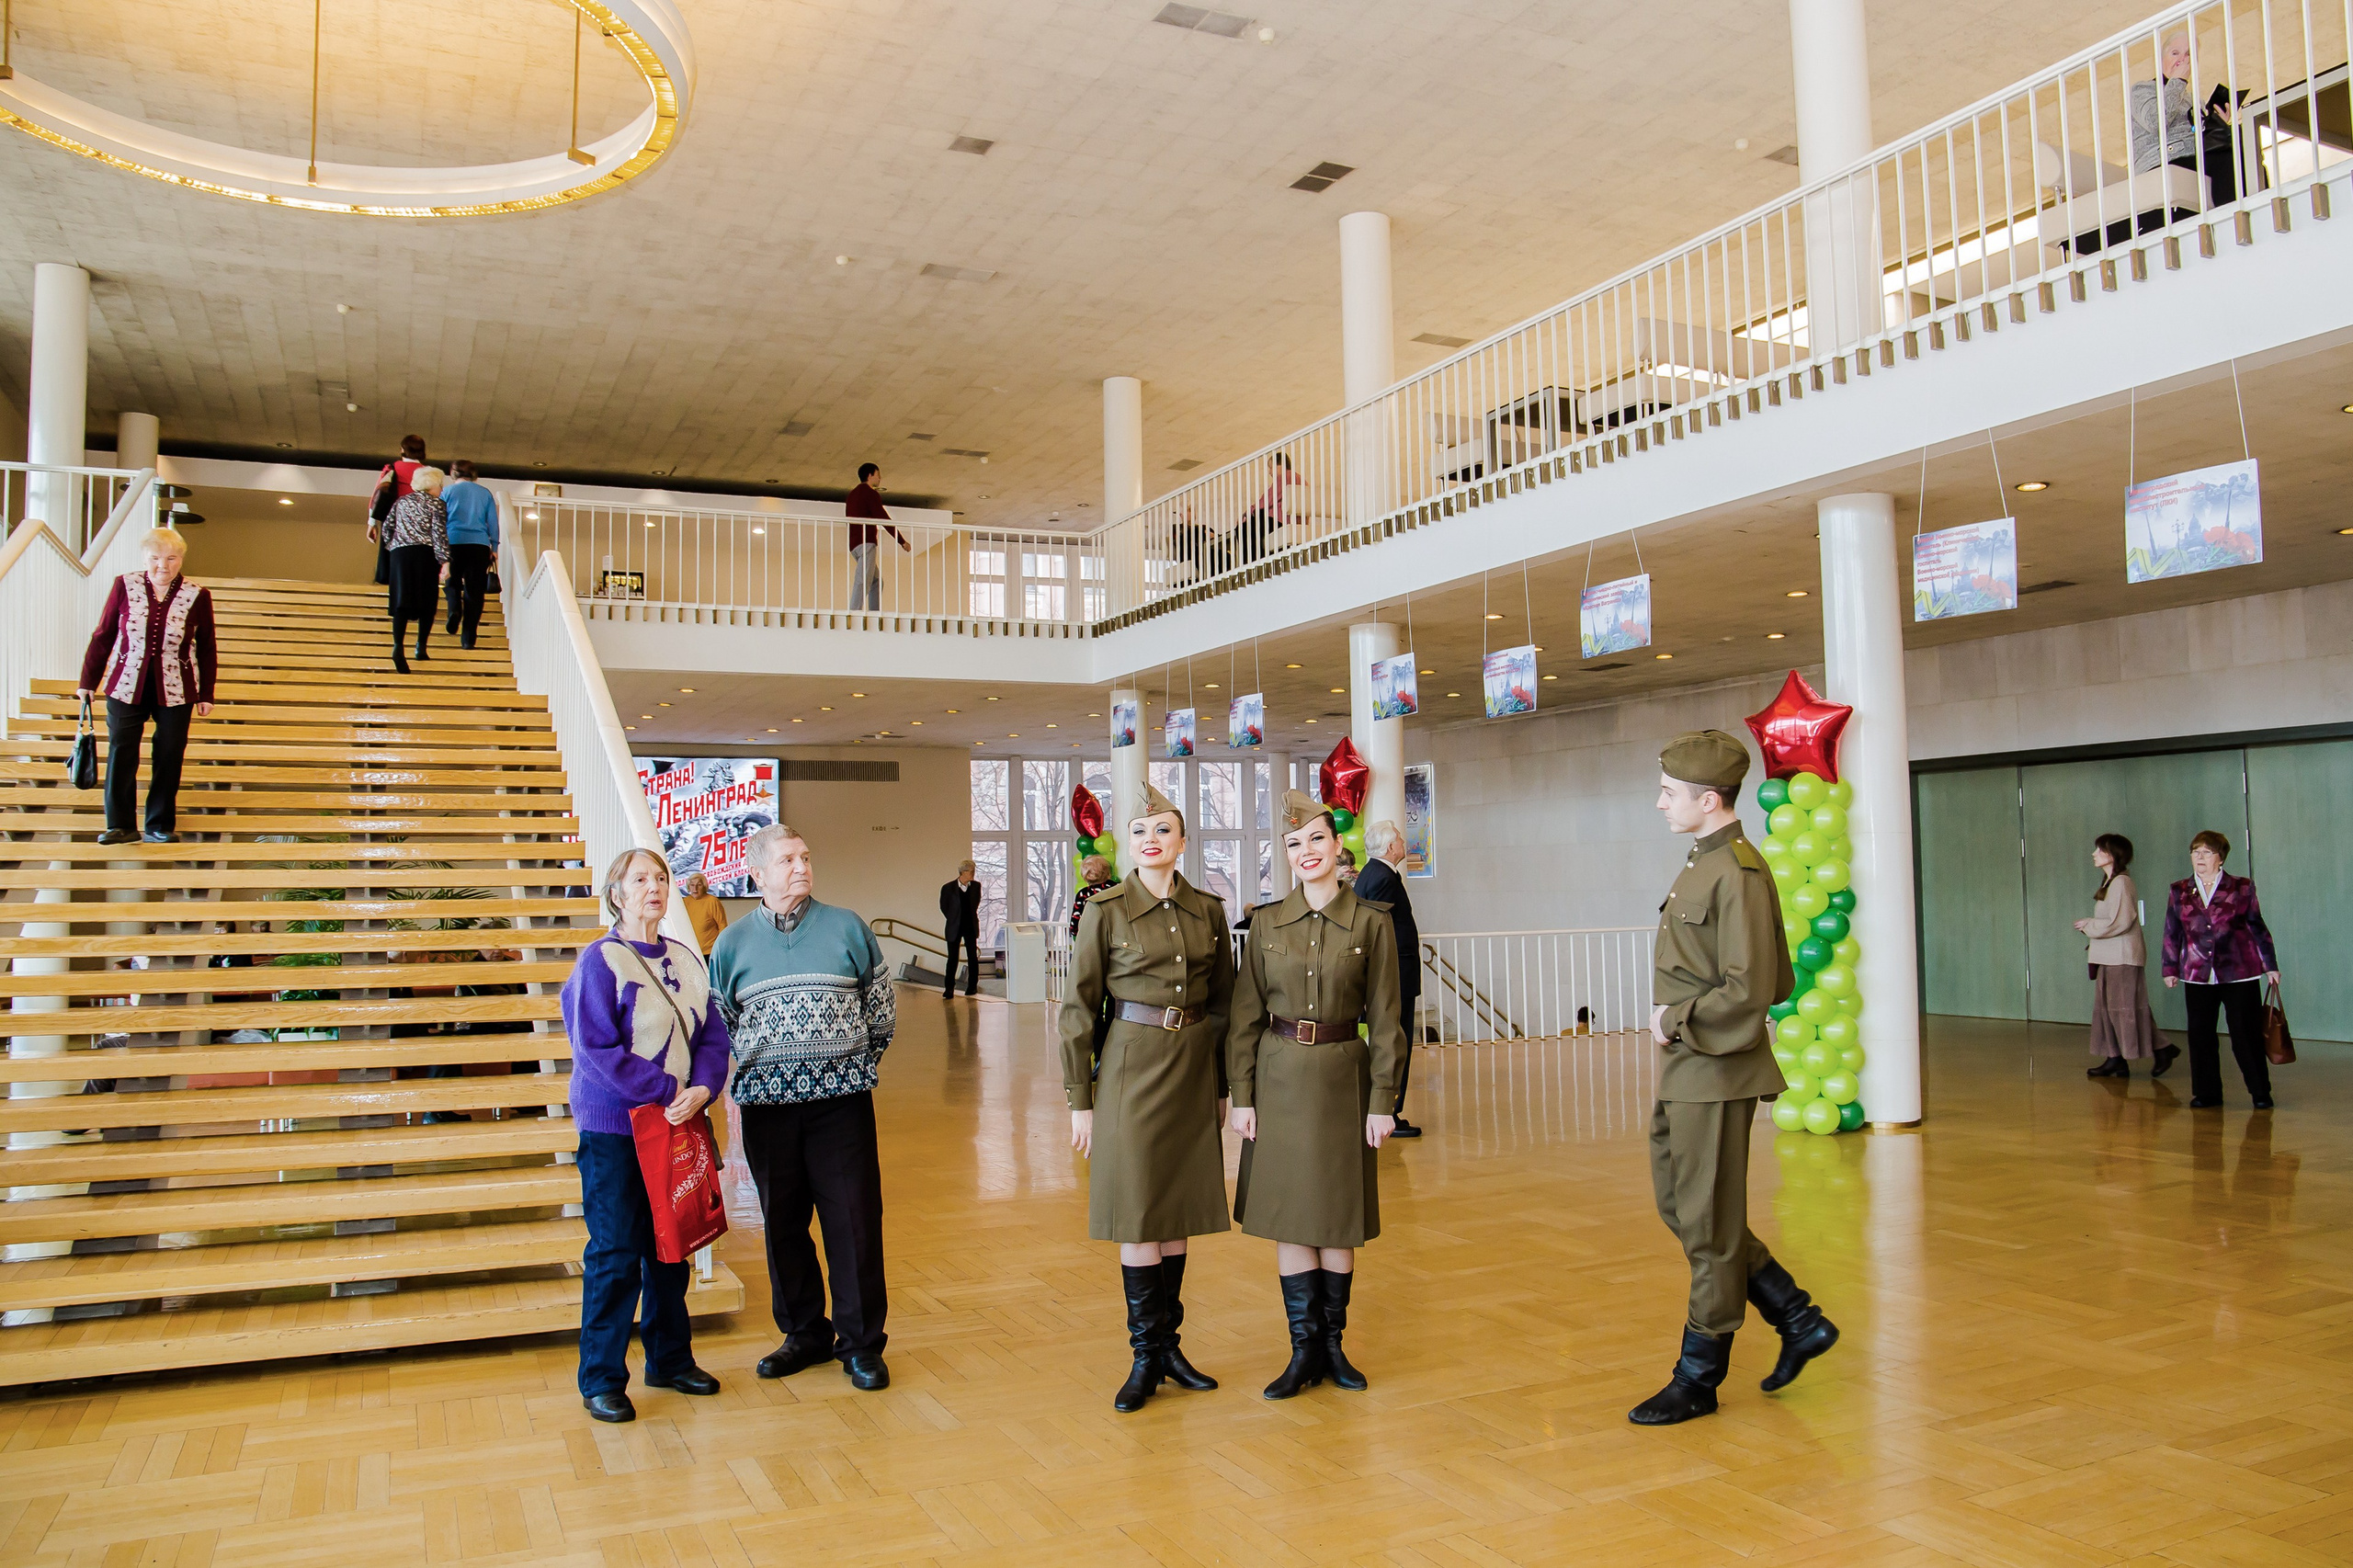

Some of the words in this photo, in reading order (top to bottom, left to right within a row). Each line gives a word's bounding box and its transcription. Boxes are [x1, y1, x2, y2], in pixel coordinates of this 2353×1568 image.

[656, 780, 757, 829] ЛЕНИНГРАД
[700, 830, 726, 870] 75
[730, 837, 750, 862] ЛЕ
